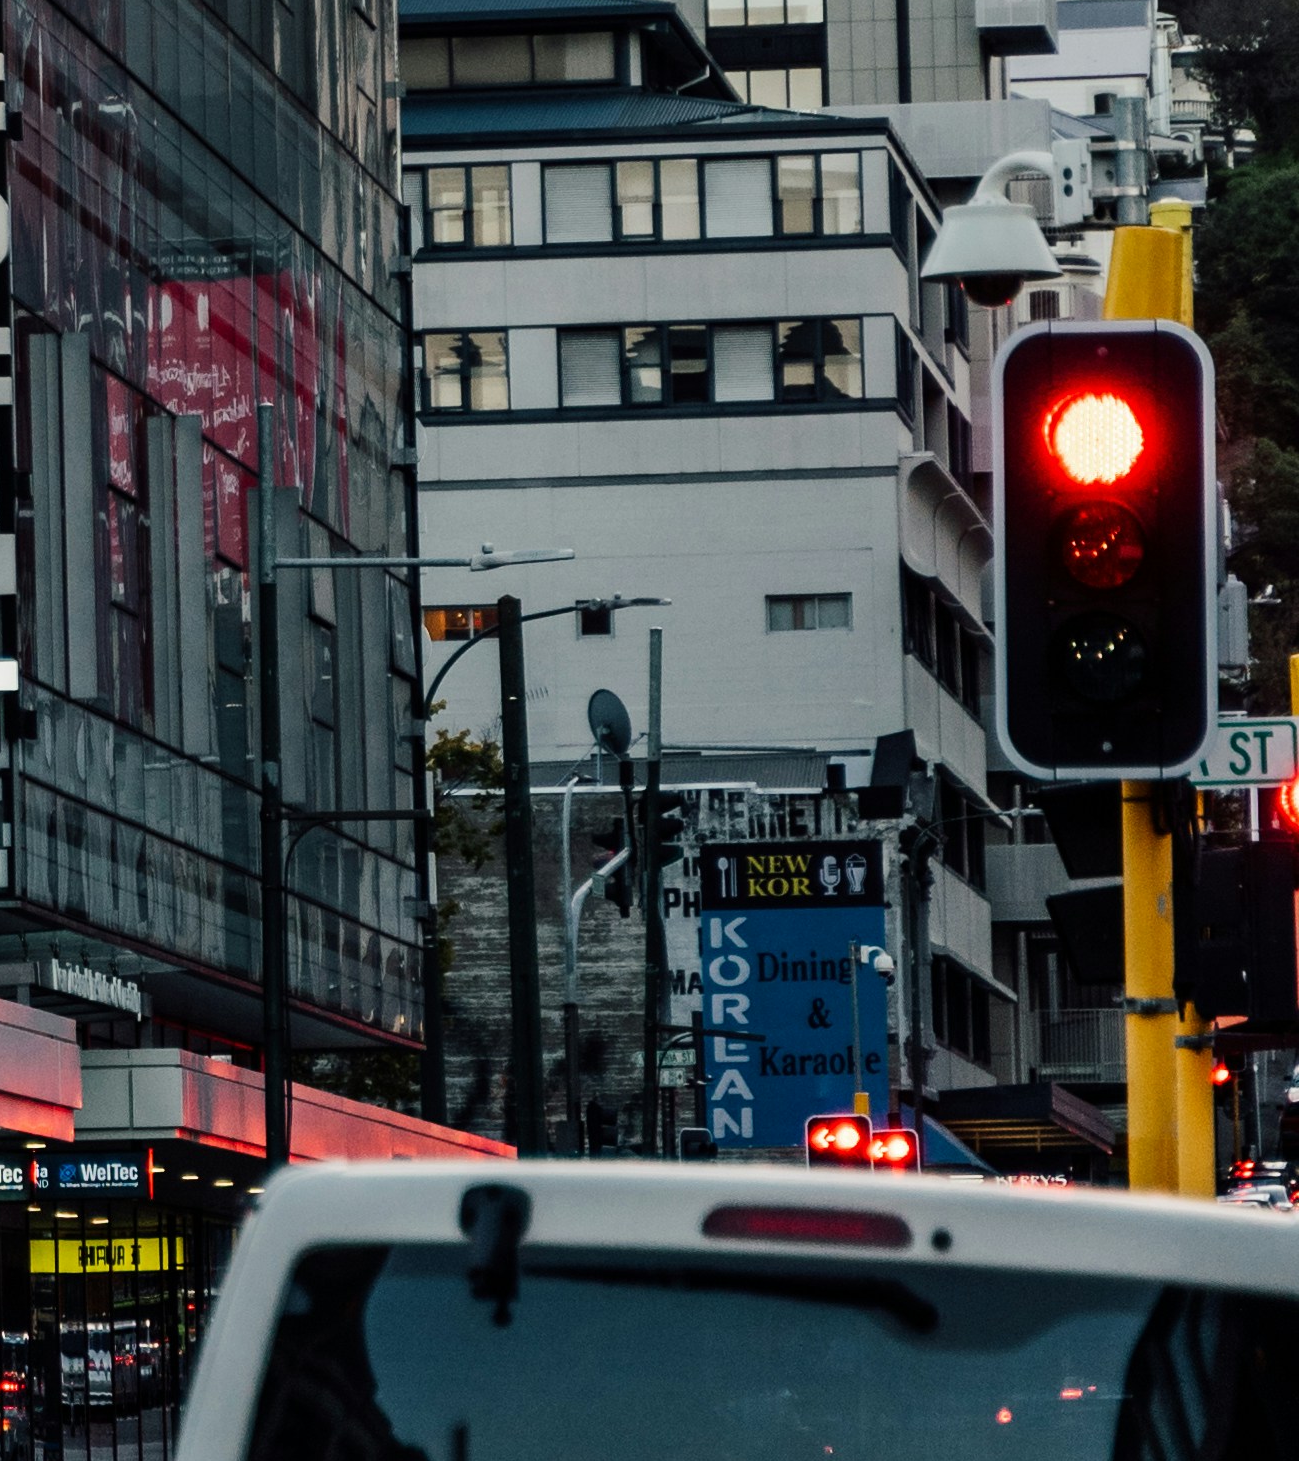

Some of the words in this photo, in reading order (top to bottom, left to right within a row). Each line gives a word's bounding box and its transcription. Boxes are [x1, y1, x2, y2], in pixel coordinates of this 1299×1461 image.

[1229, 730, 1274, 776] ST
[746, 855, 813, 875] NEW
[747, 878, 814, 897] KOR
[757, 950, 857, 986] Dining
[709, 916, 755, 1140] KOREAN
[807, 997, 834, 1029] &
[80, 1163, 139, 1181] WelTec
